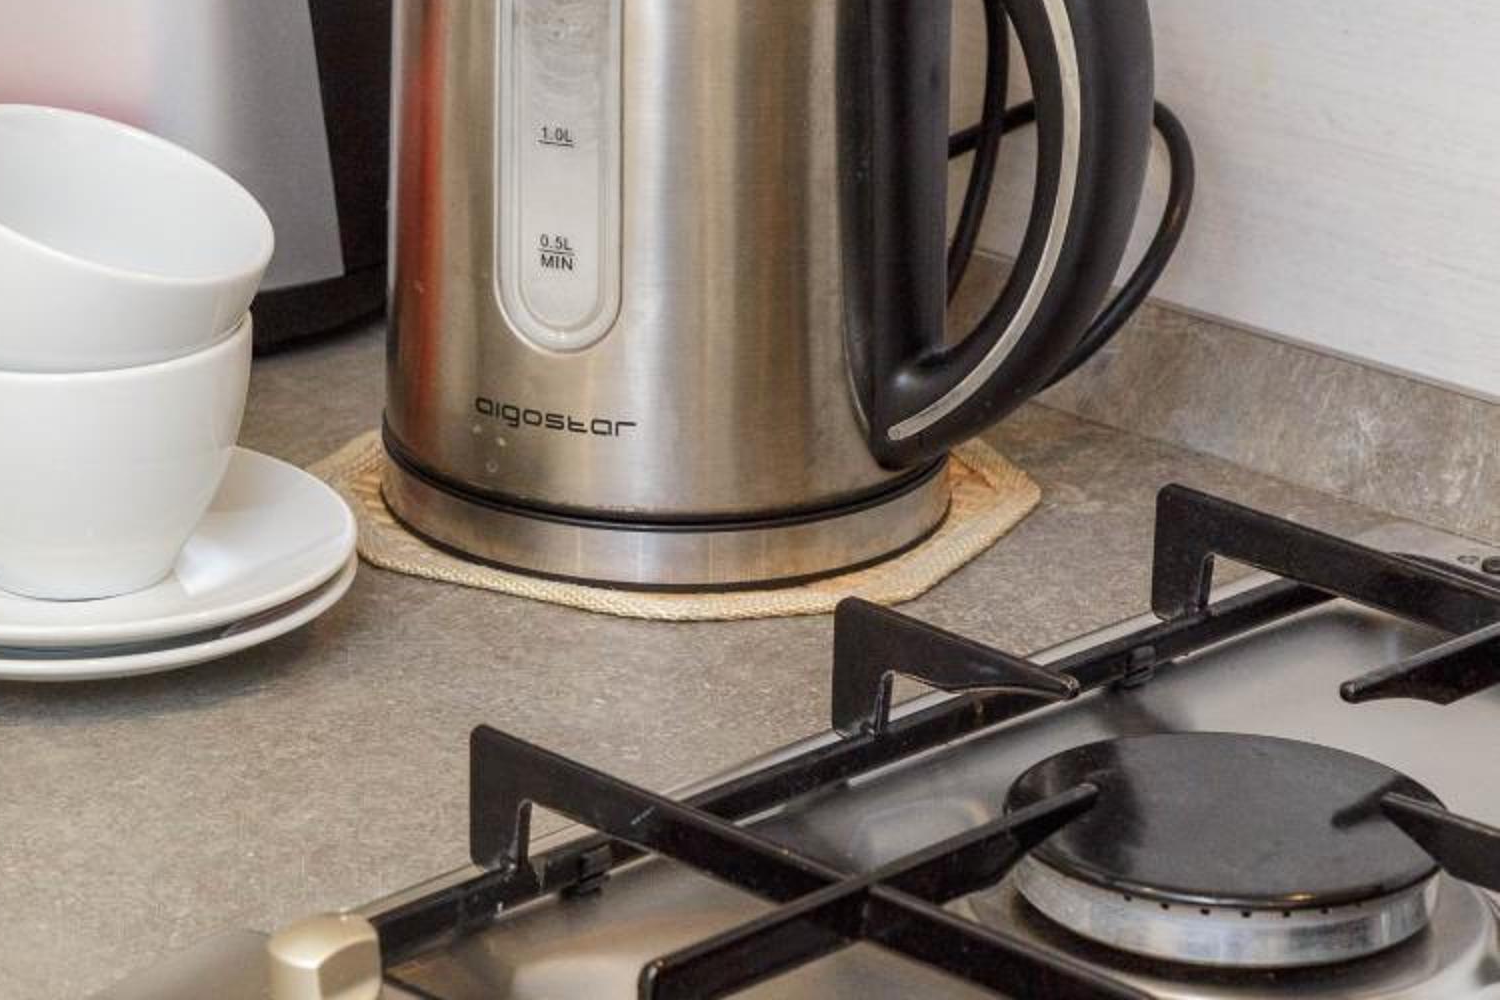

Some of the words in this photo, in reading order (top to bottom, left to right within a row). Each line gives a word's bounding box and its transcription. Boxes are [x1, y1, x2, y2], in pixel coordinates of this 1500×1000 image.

[540, 126, 573, 143] 1.0L
[540, 233, 573, 251] 0.5L
[541, 253, 573, 271] MIN
[475, 395, 637, 437] aigostar
